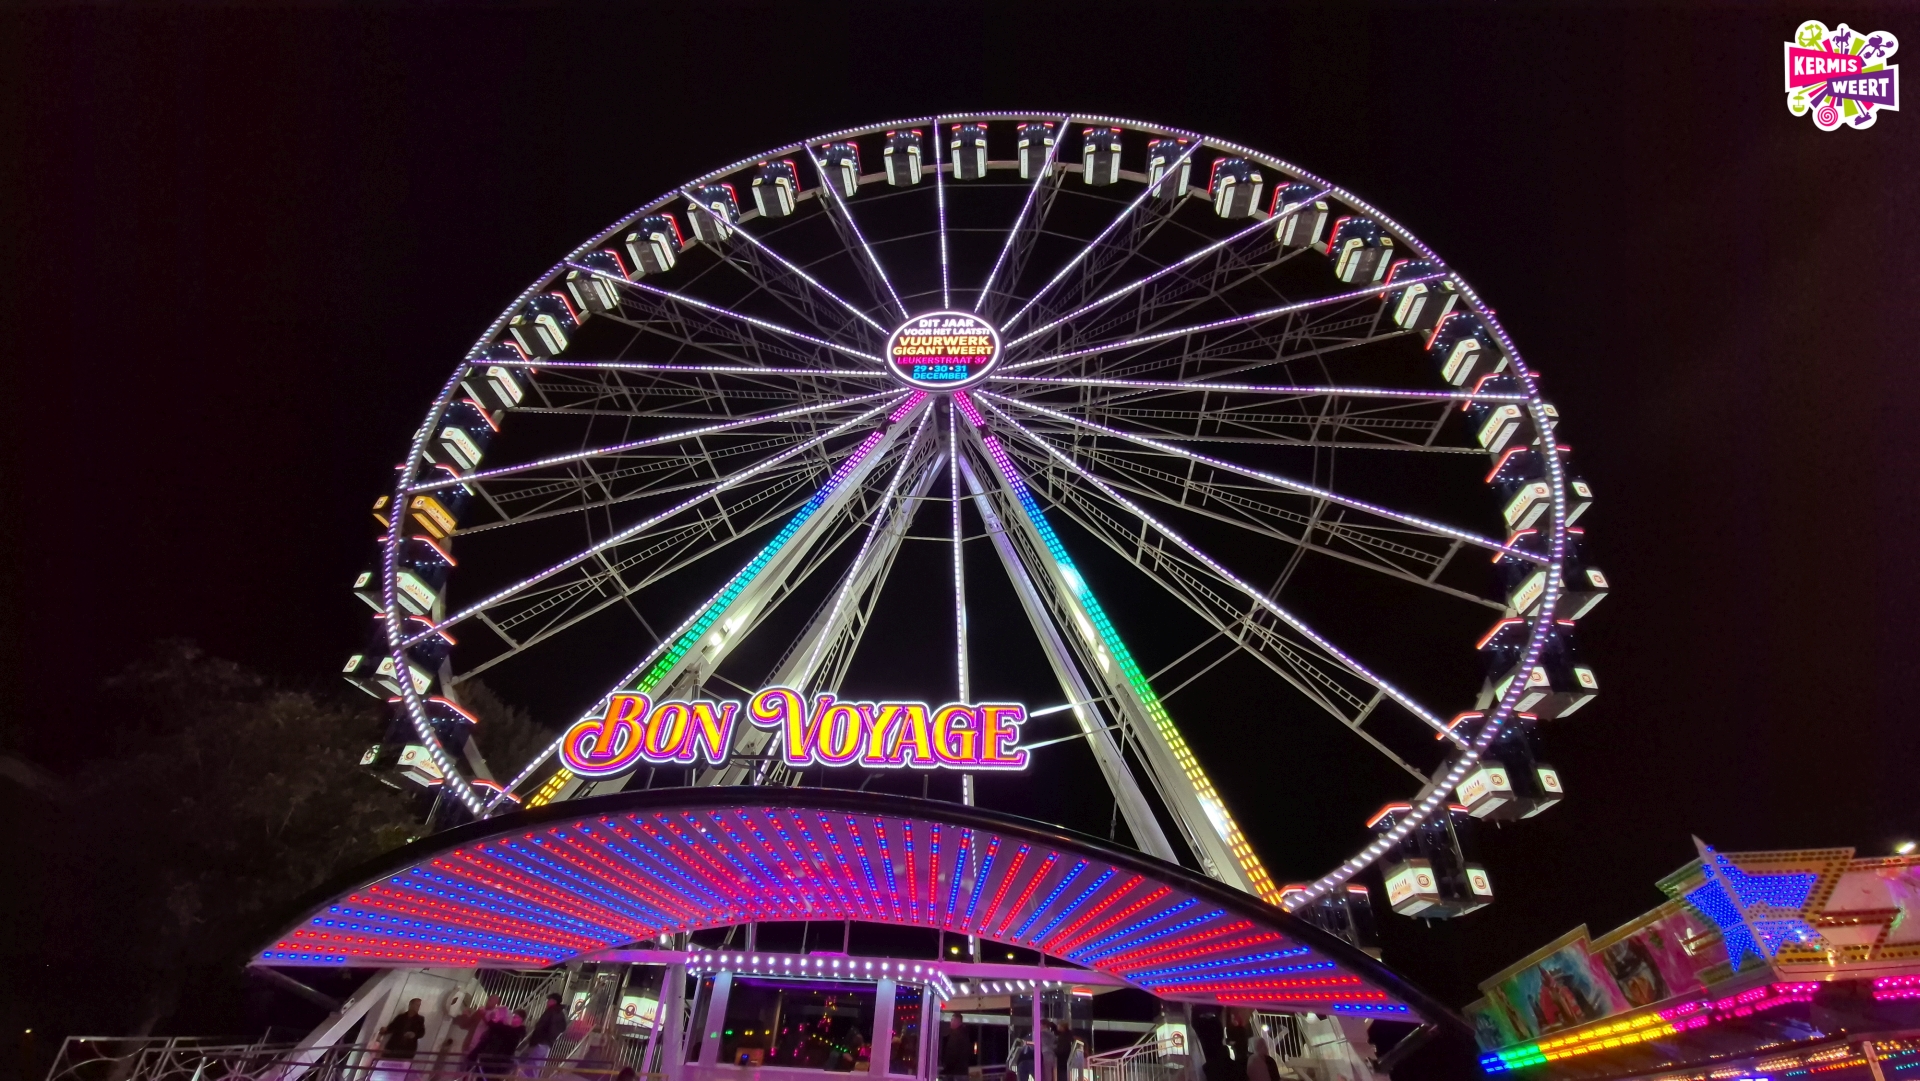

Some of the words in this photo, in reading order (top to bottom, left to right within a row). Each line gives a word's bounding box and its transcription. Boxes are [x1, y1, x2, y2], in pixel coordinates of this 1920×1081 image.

[919, 319, 940, 327] DIT
[942, 319, 974, 327] JAAR
[899, 336, 989, 346] VUURWERK
[892, 346, 943, 355] GIGANT
[947, 346, 993, 355] WEERT
[897, 356, 972, 364] LEUKERSTRAAT
[974, 356, 987, 364] 37
[562, 692, 737, 773] BON
[750, 688, 1026, 768] VOYAGE
